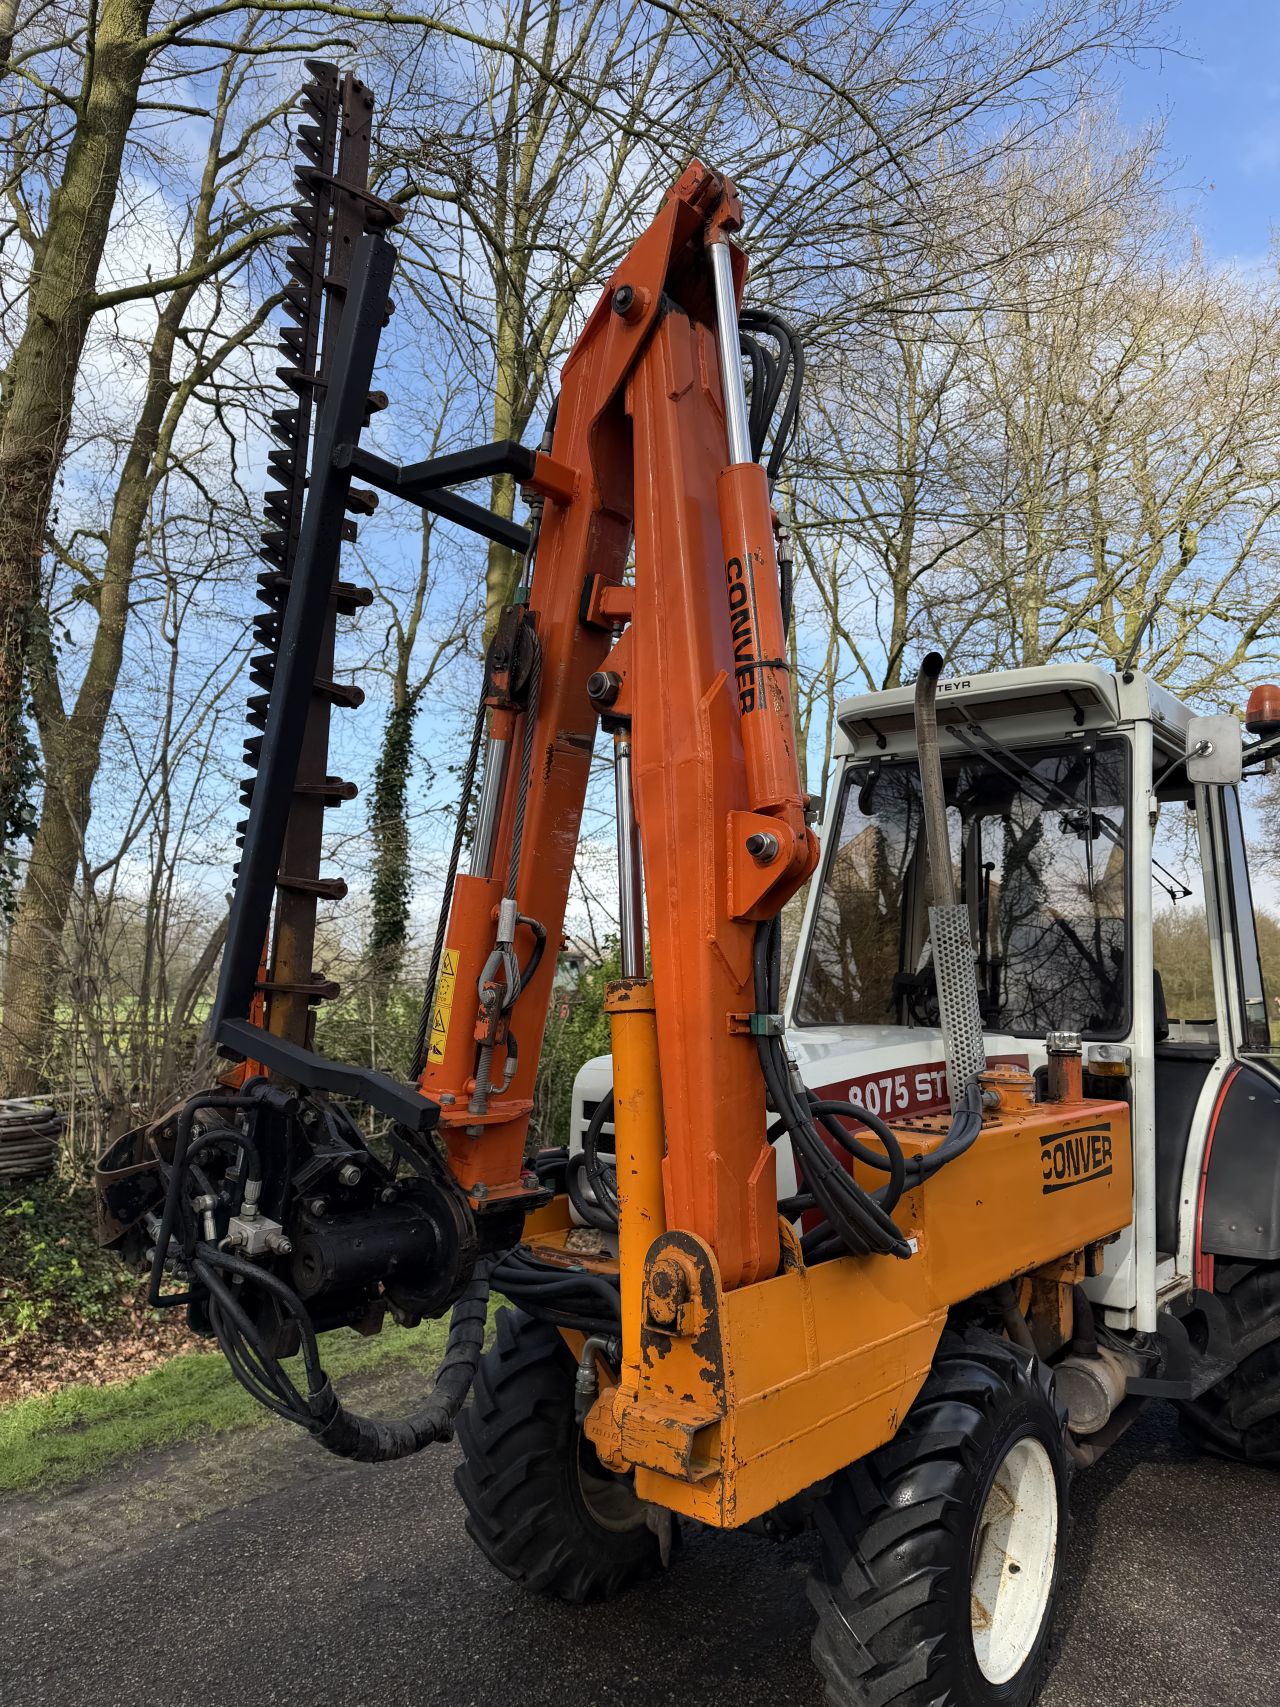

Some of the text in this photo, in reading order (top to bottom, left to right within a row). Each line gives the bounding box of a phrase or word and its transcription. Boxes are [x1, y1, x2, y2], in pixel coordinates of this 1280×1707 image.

[726, 557, 755, 716] CONVER
[937, 681, 971, 692] TEYR
[848, 1070, 950, 1116] 8075 ST
[1041, 1135, 1112, 1180] CONVER
